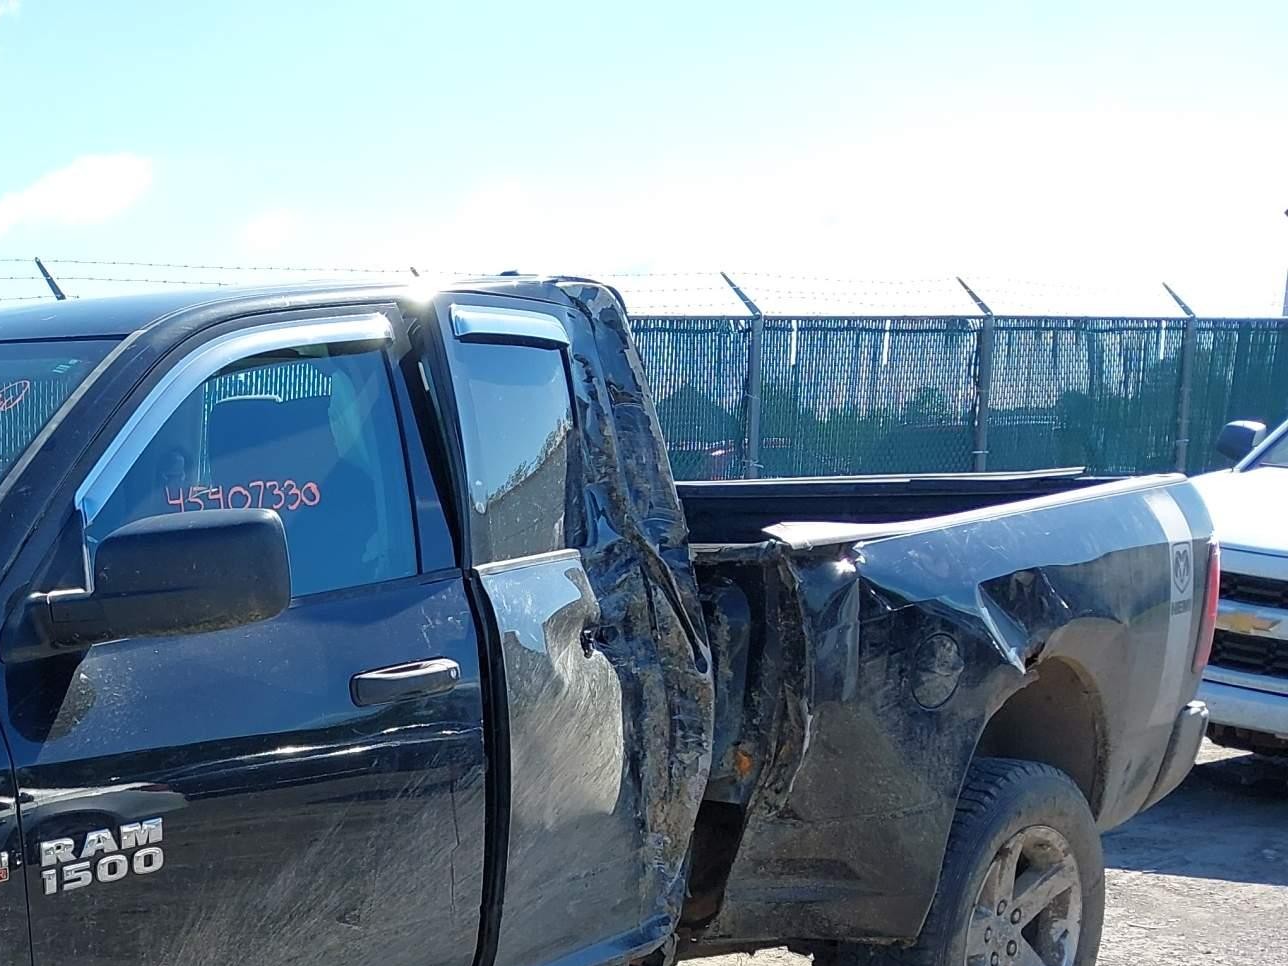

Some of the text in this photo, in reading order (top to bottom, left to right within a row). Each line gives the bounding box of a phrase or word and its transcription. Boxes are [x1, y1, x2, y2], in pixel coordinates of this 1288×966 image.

[165, 479, 321, 513] 45407330
[39, 817, 164, 867] RAM
[40, 847, 165, 895] 1500
